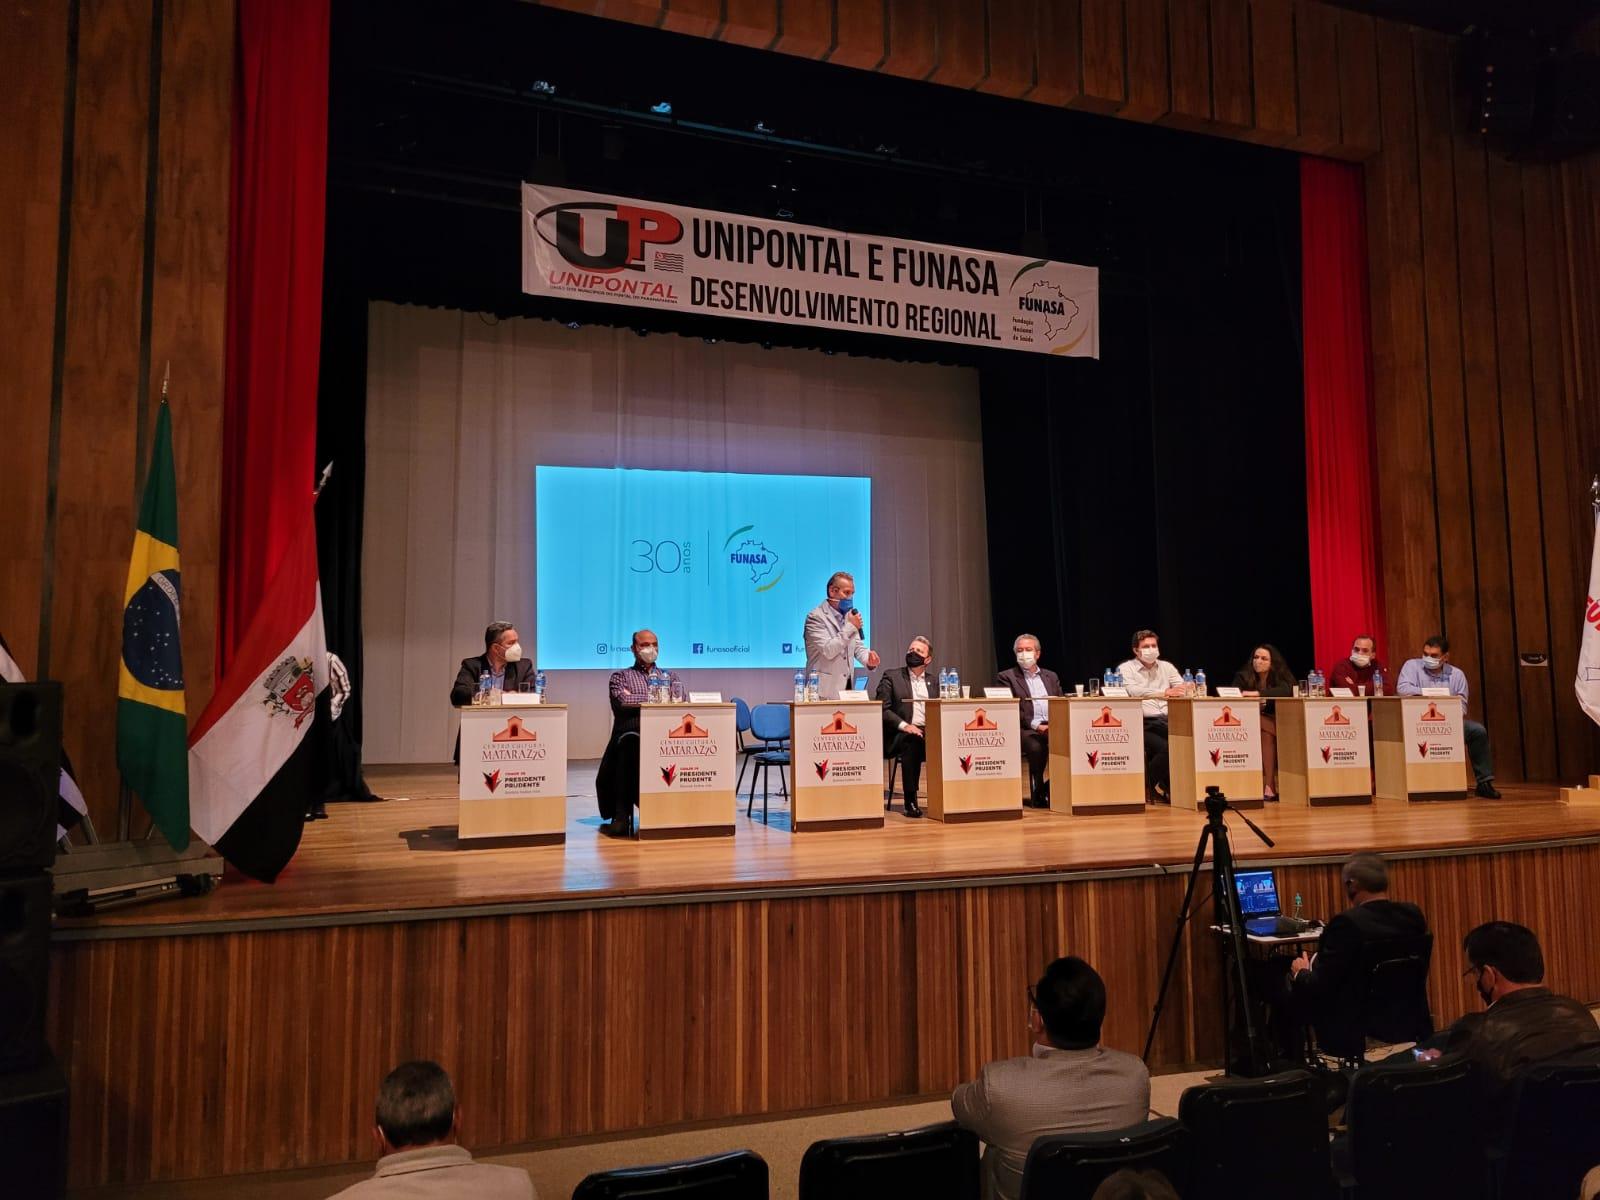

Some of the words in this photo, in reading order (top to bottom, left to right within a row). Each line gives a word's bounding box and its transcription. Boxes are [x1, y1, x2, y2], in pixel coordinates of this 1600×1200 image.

[693, 217, 859, 279] UNIPONTAL
[867, 243, 884, 282] E
[892, 247, 999, 297] FUNASA
[549, 270, 678, 299] UNIPONTAL
[690, 276, 899, 330] DESENVOLVIMENTO
[905, 303, 1002, 341] REGIONAL
[1018, 296, 1065, 316] FUNASA
[630, 539, 682, 574] 30
[683, 541, 691, 574] anos
[730, 553, 768, 565] FUNASA
